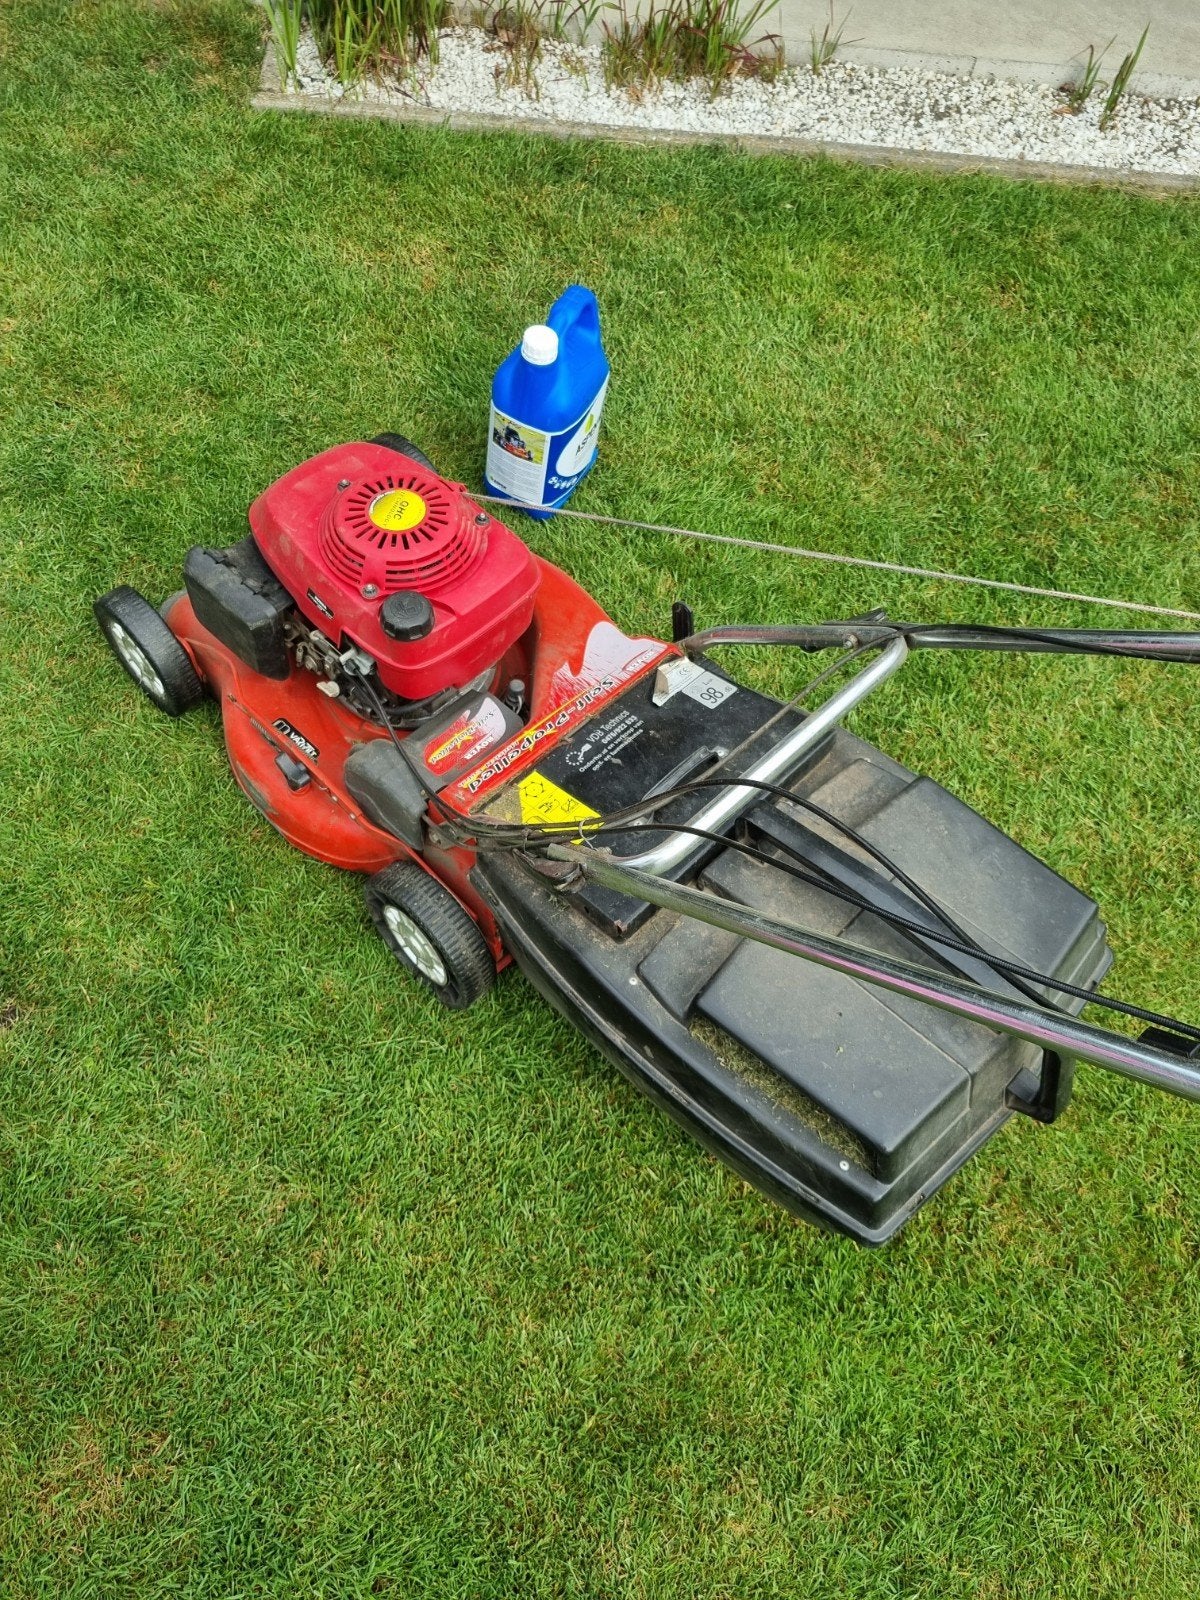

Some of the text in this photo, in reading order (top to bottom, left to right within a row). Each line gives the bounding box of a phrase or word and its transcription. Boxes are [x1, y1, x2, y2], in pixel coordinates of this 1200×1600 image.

[700, 687, 724, 704] 98
[468, 678, 615, 793] Self-Propelled
[586, 710, 630, 743] VDB Technics
[464, 733, 495, 760] ROVER
